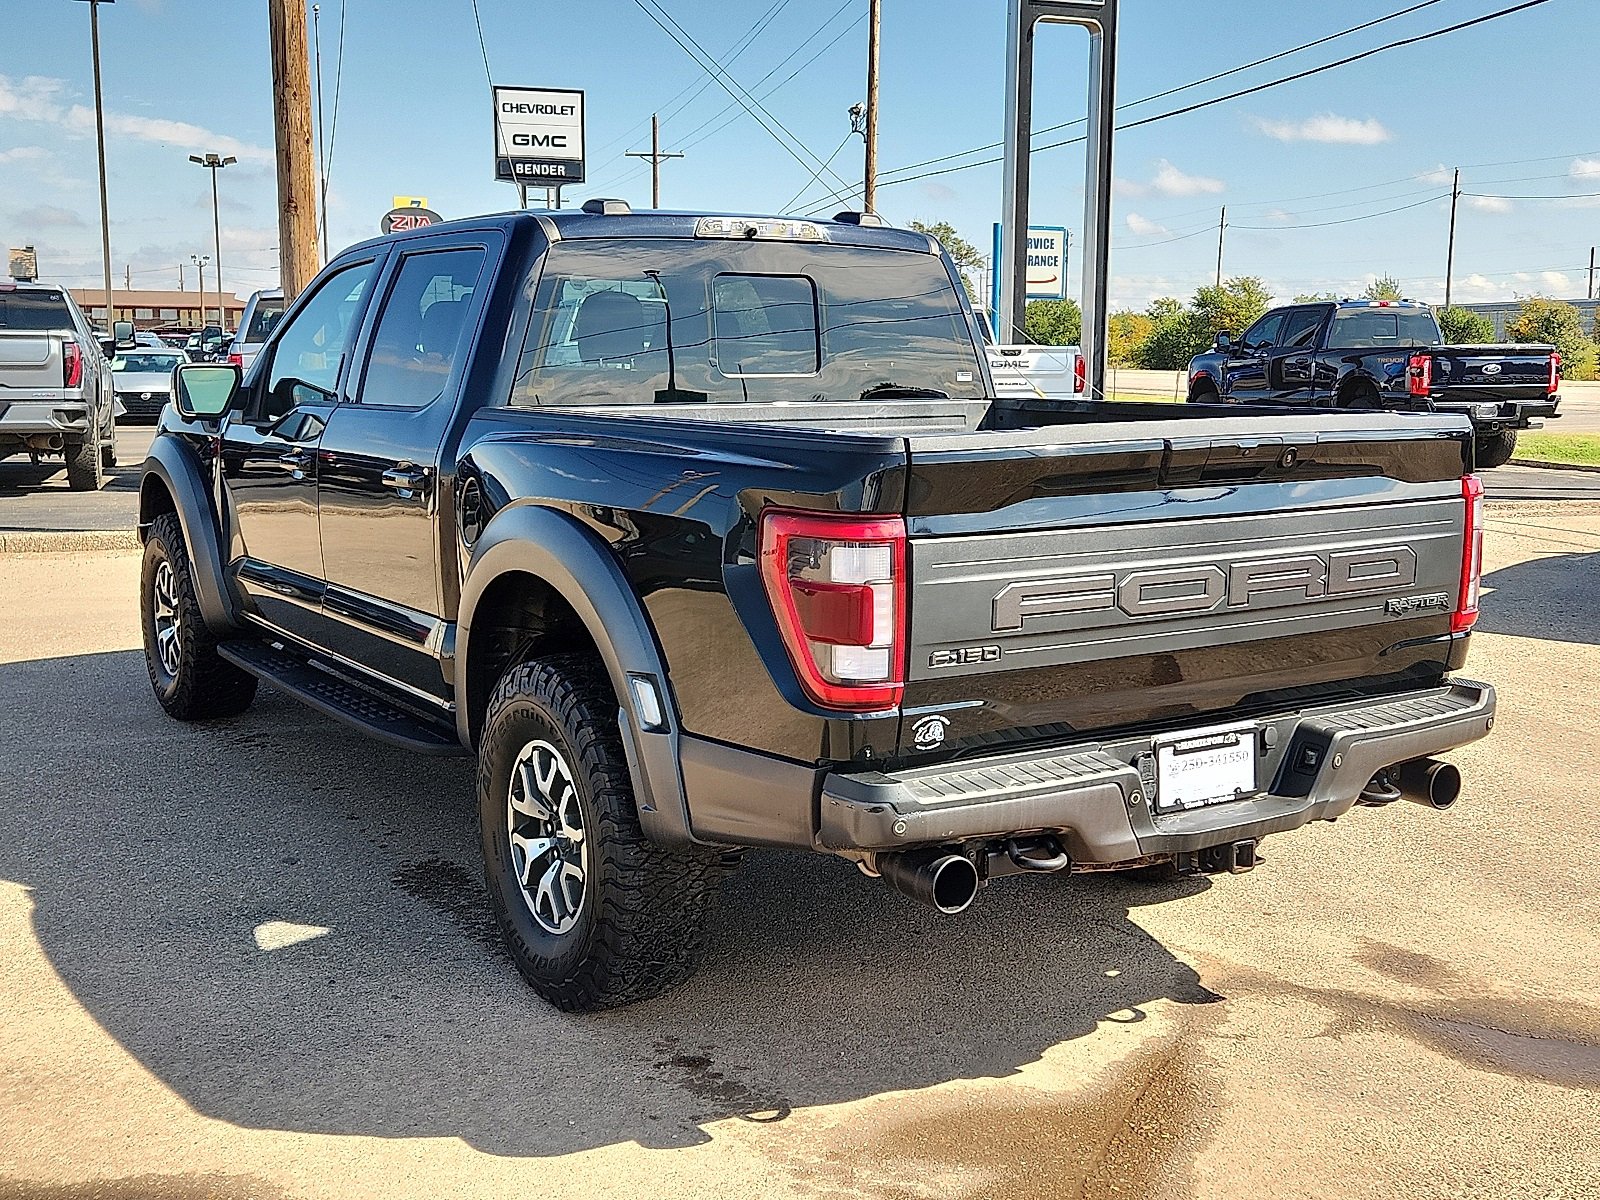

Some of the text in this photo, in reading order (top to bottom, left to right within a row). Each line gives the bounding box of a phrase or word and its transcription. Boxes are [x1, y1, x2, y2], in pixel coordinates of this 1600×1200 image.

[502, 102, 575, 116] CHEVROLET
[512, 133, 567, 147] GMC
[515, 163, 566, 176] BENDER
[389, 214, 432, 232] ZIA
[991, 360, 1030, 368] GMC
[991, 543, 1419, 633] FORD
[1386, 591, 1450, 617] RAPTOR
[928, 645, 1002, 668] F-150
